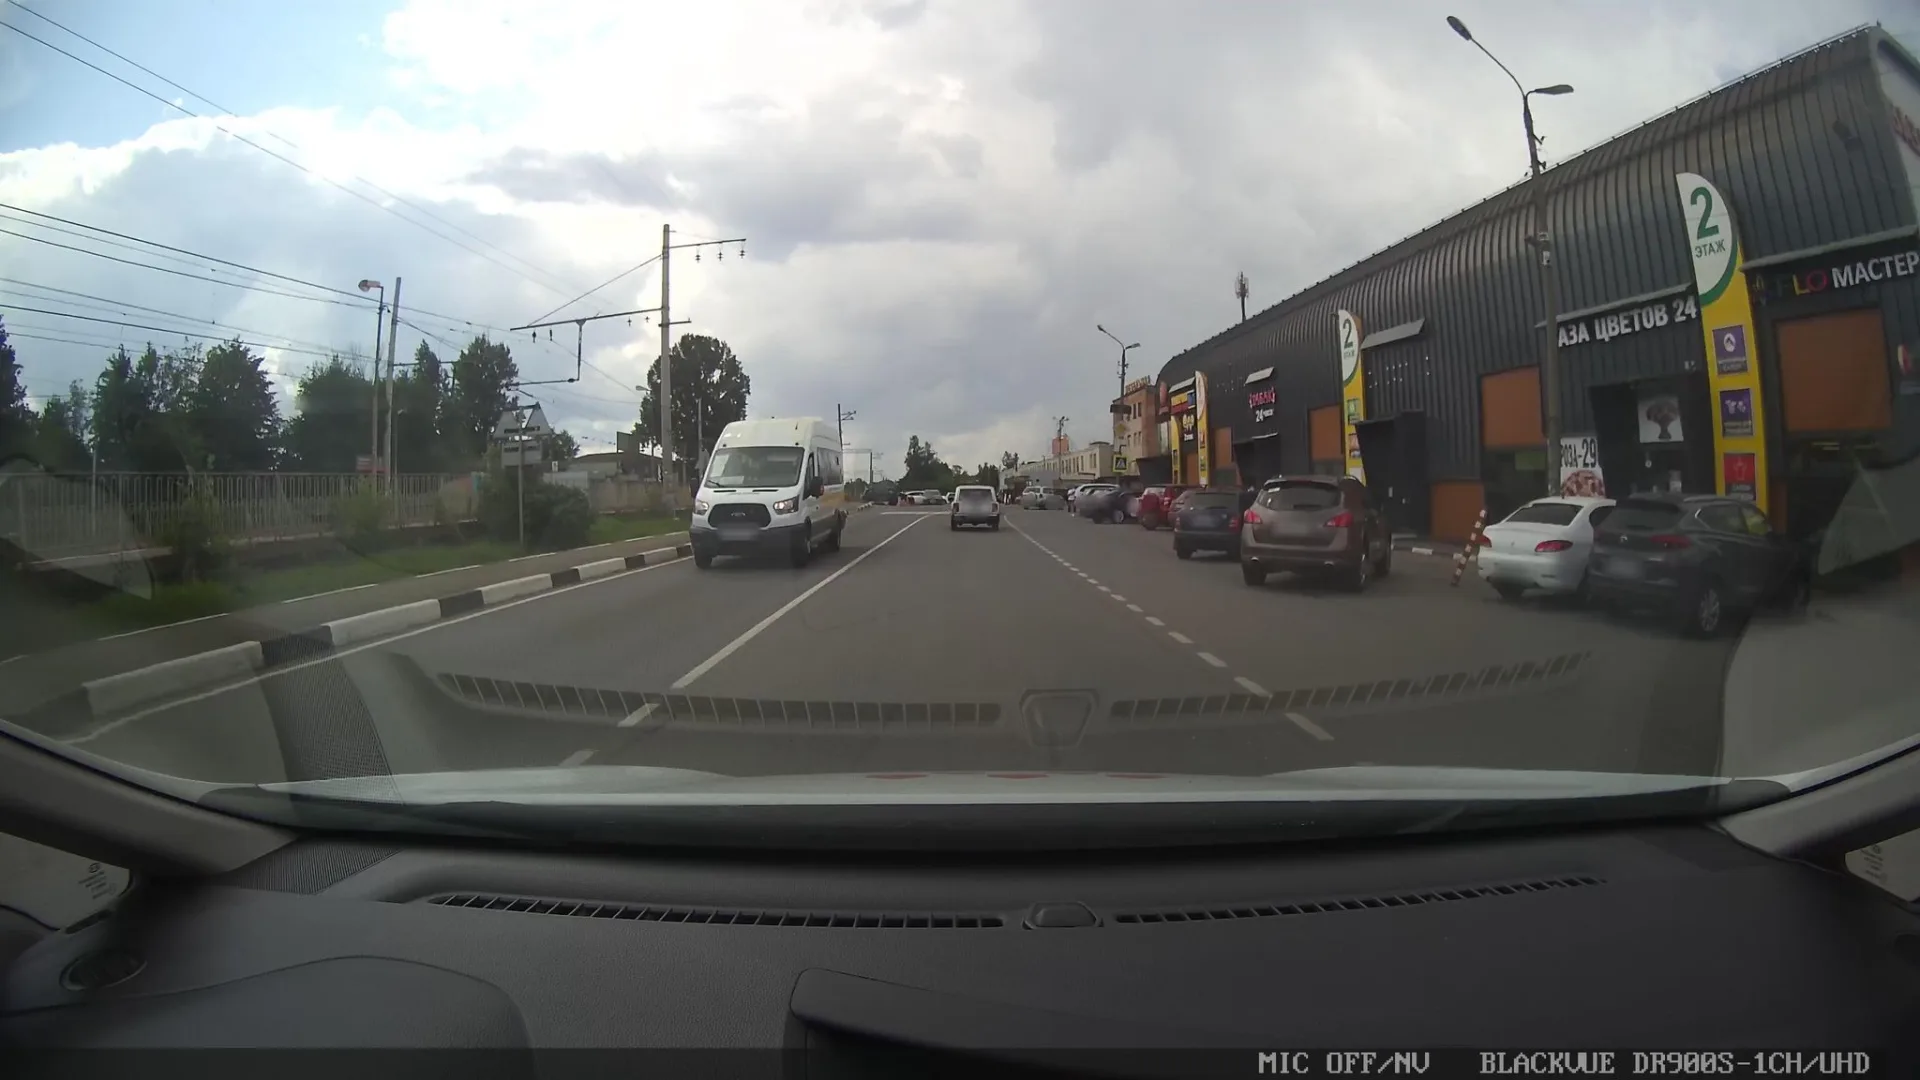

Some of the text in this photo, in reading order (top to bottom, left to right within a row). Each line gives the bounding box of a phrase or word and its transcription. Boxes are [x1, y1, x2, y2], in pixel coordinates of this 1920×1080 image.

[1690, 187, 1719, 240] 2
[1694, 240, 1726, 258] ЭТАЖ
[1831, 251, 1920, 288] МАСТЕР
[1343, 318, 1353, 348] 2
[1558, 296, 1697, 347] АЗА ЦВЕТОВ 24
